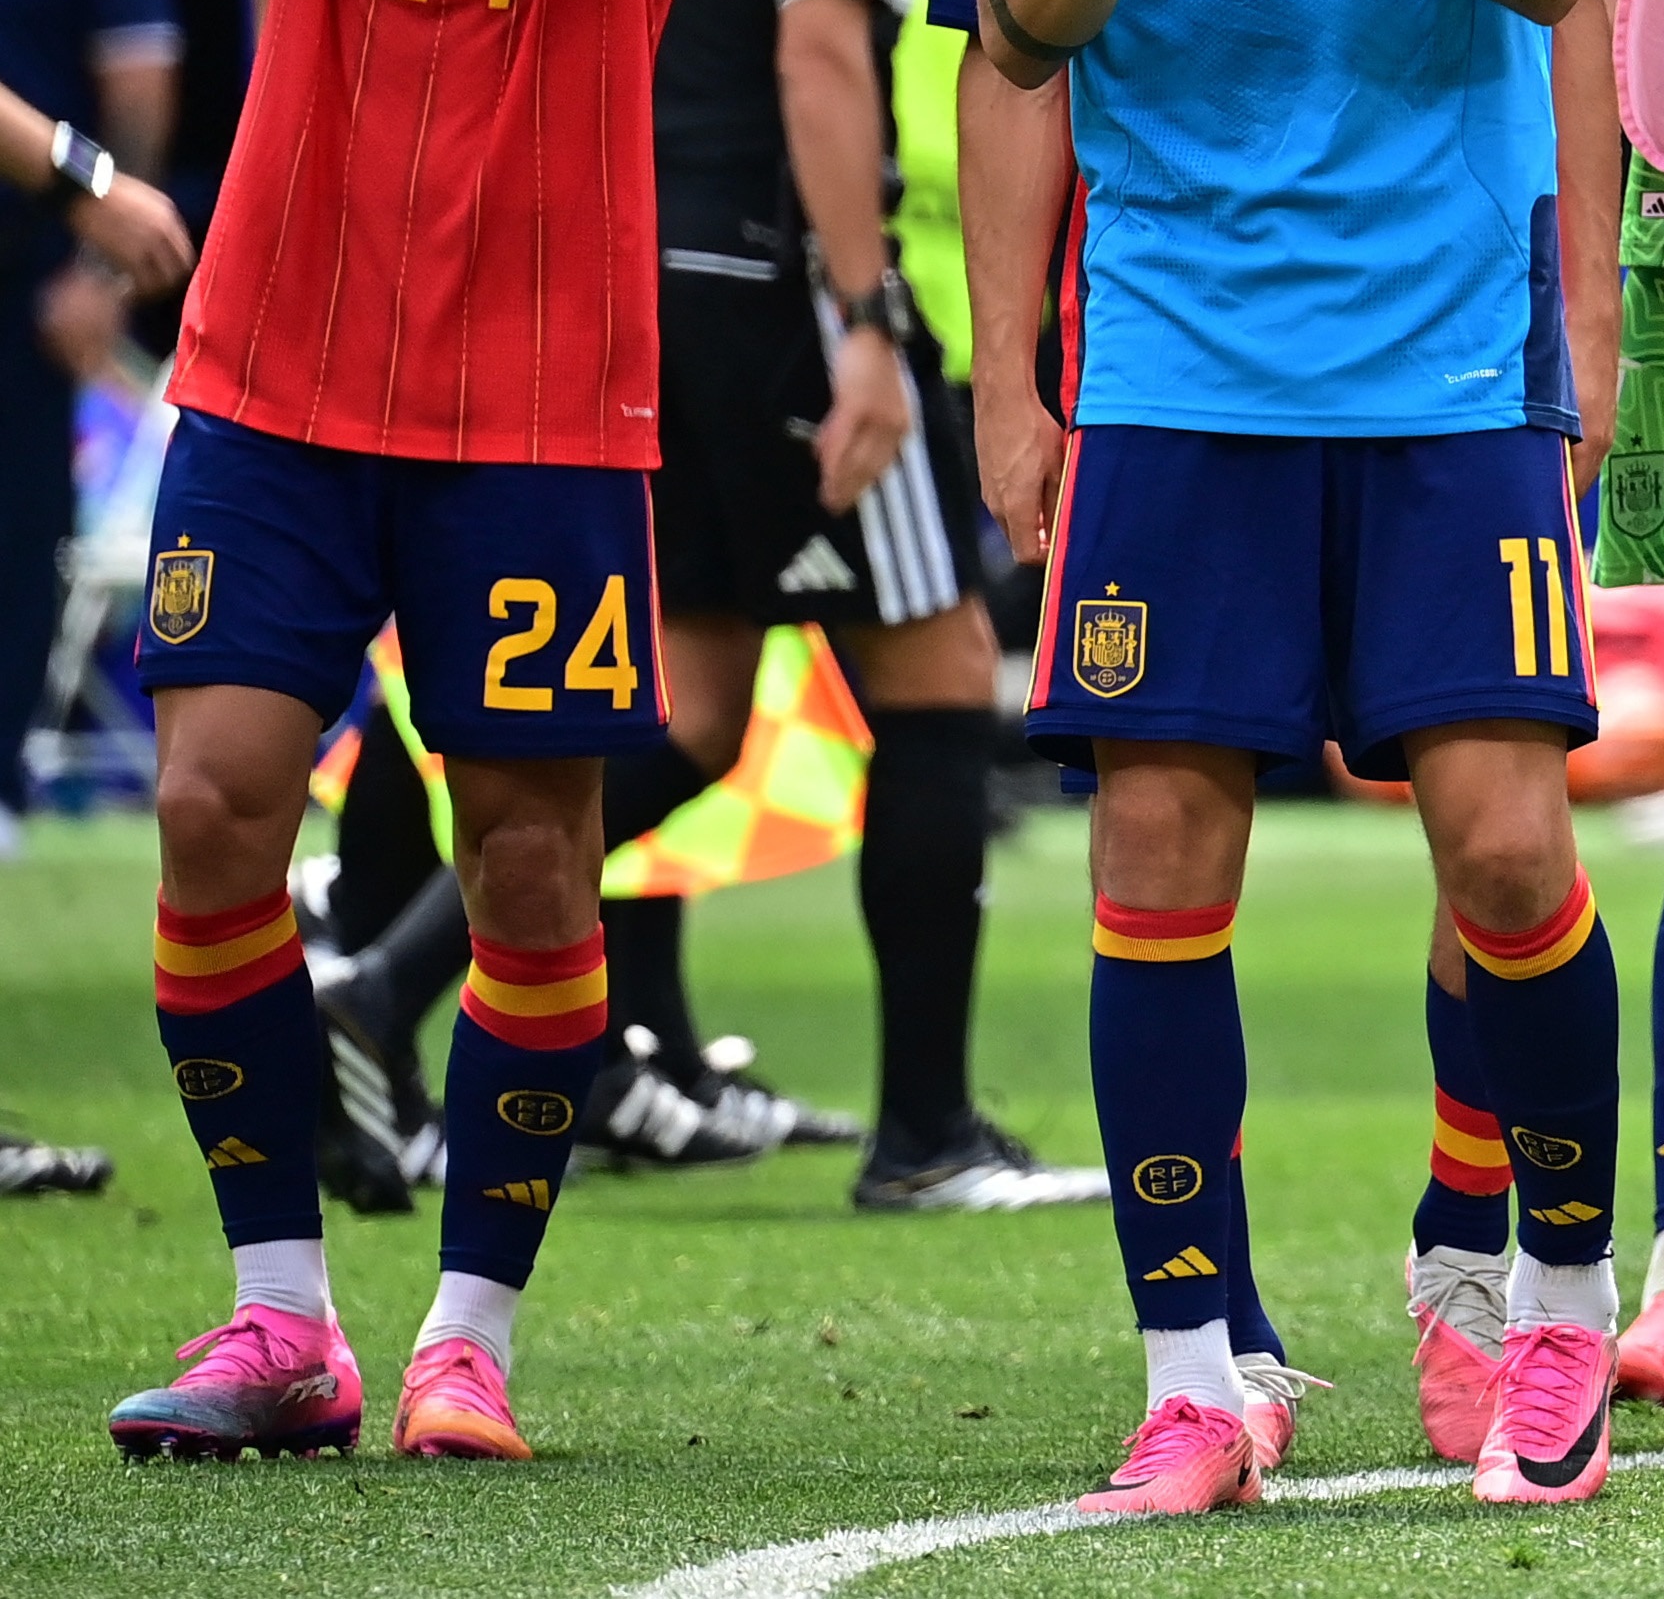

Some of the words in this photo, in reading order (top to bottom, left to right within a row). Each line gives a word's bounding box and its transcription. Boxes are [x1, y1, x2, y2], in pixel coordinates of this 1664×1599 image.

[1447, 369, 1499, 385] CLIMACOOL
[483, 574, 639, 712] 24
[1499, 538, 1570, 677] 11
